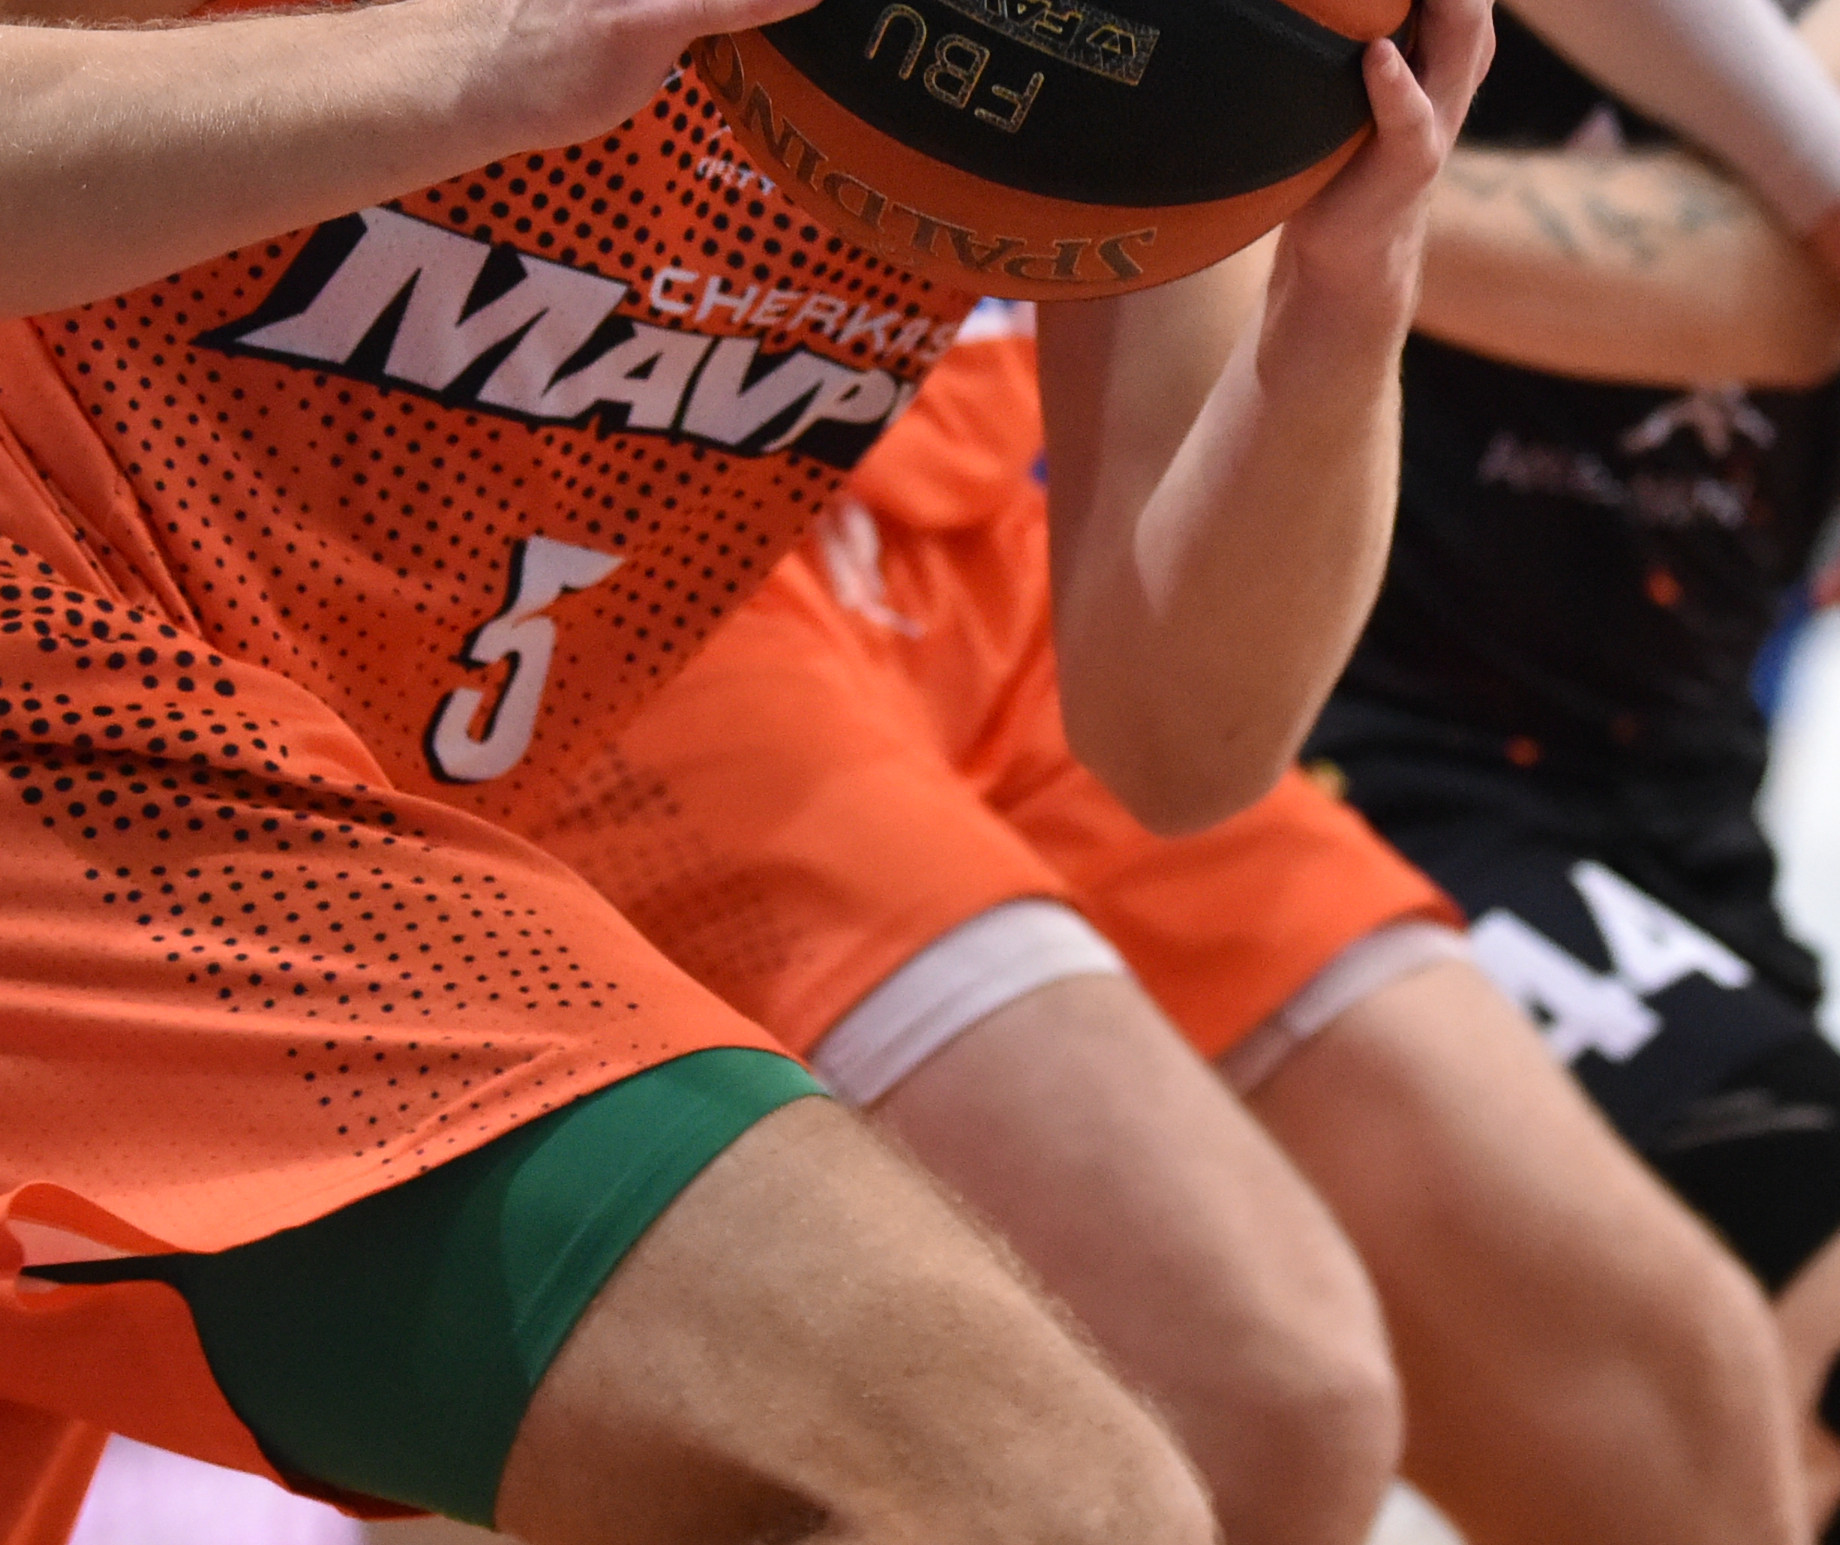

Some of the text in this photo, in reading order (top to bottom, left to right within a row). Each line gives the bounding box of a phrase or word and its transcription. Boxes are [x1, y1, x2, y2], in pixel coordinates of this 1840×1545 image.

[864, 2, 1045, 134] FBU
[424, 535, 627, 784] 5
[1464, 856, 1757, 1064] 44
